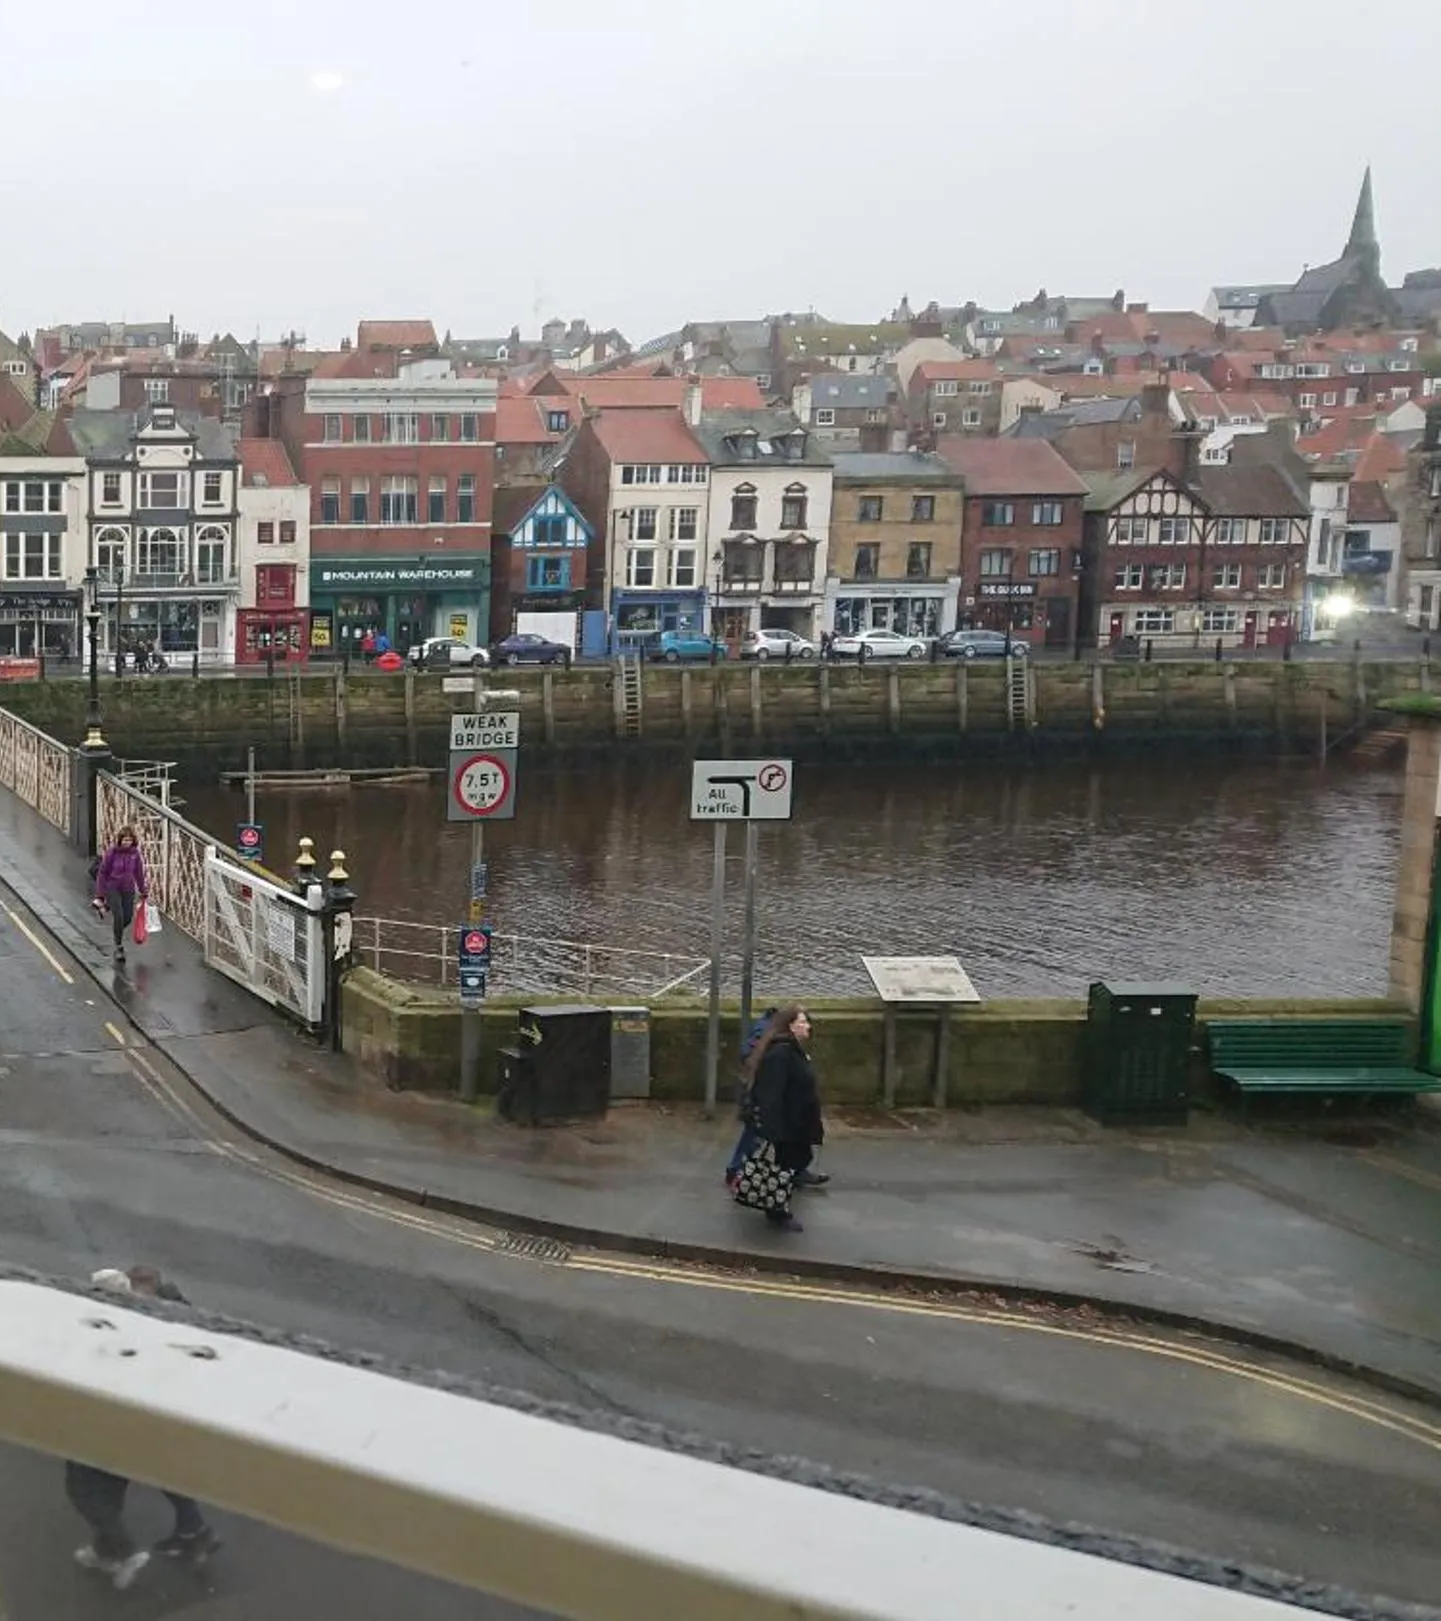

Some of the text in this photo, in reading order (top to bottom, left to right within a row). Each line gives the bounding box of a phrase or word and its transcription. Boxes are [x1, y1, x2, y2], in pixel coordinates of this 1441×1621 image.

[331, 569, 475, 581] MOUNTAIN WAREHOUSE
[463, 716, 508, 729] WEAK
[455, 732, 514, 746] BRIDGE
[708, 789, 726, 799] All
[697, 803, 739, 813] traffic
